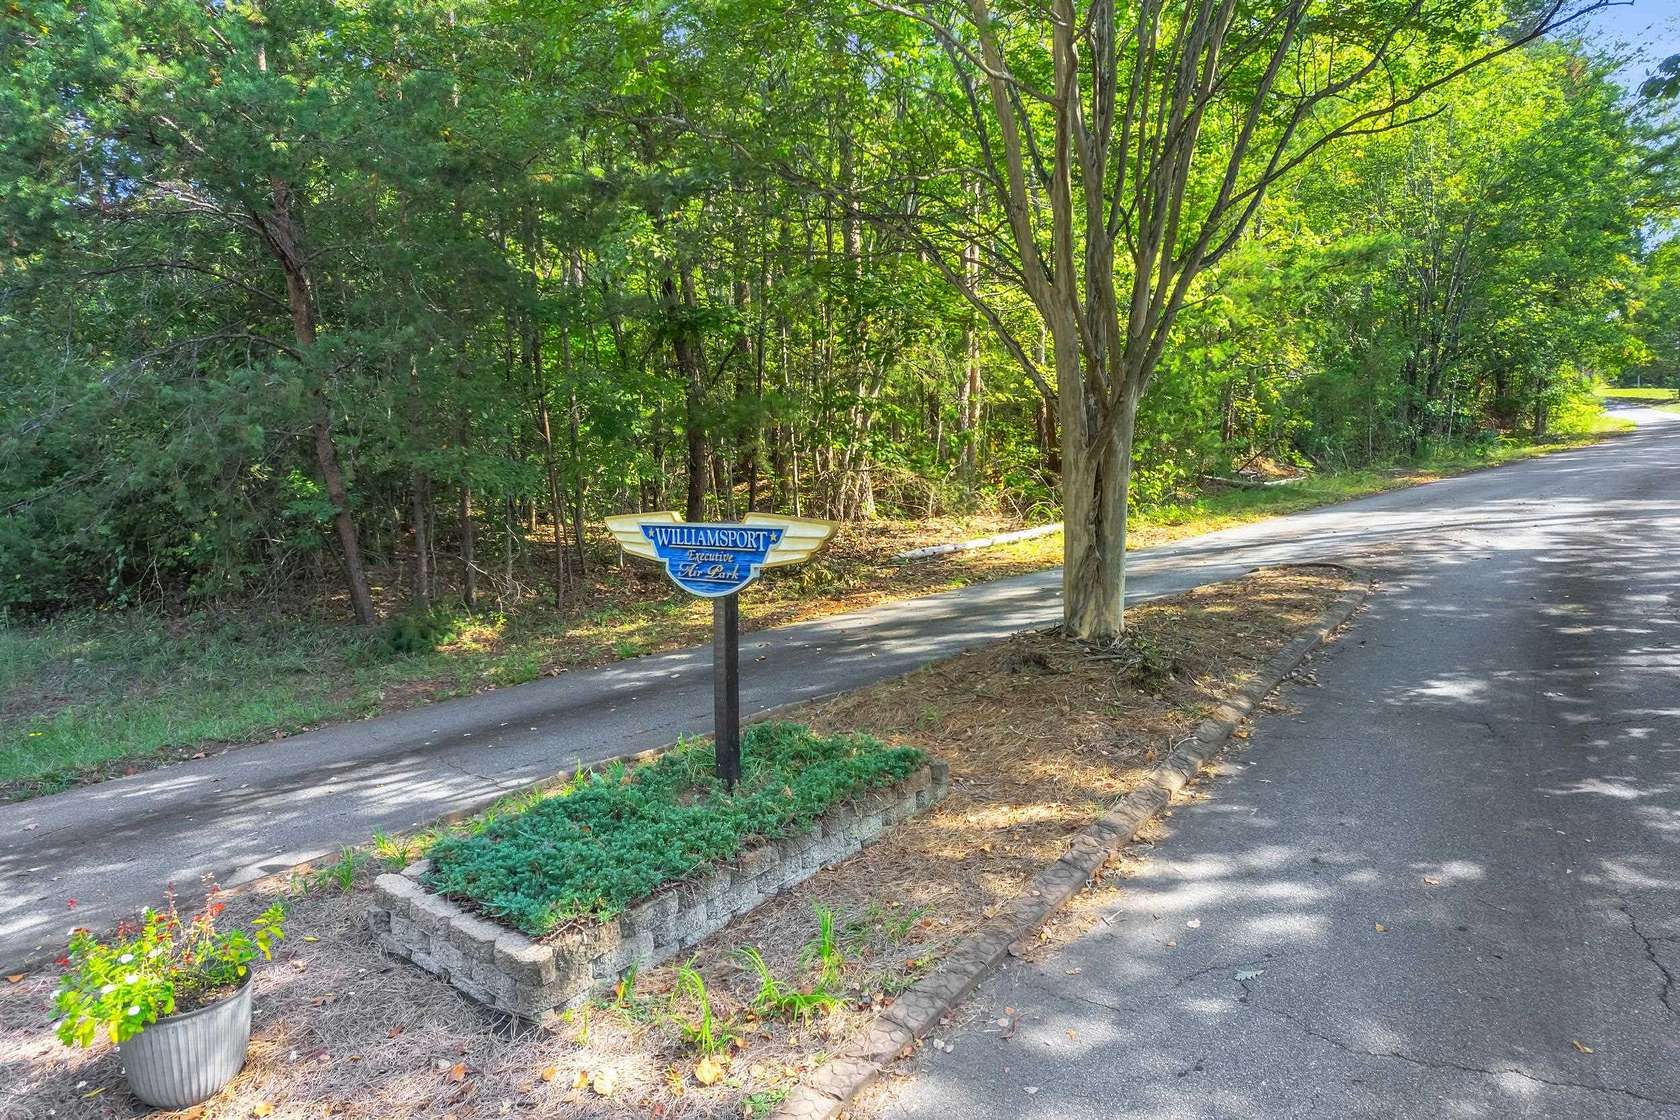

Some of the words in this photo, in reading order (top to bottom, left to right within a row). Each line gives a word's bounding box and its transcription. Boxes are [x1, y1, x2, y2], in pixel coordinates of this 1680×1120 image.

[655, 527, 768, 551] WILLIAMSPORT
[687, 549, 734, 563] Executive
[678, 562, 702, 578] Air
[705, 564, 739, 580] Park
